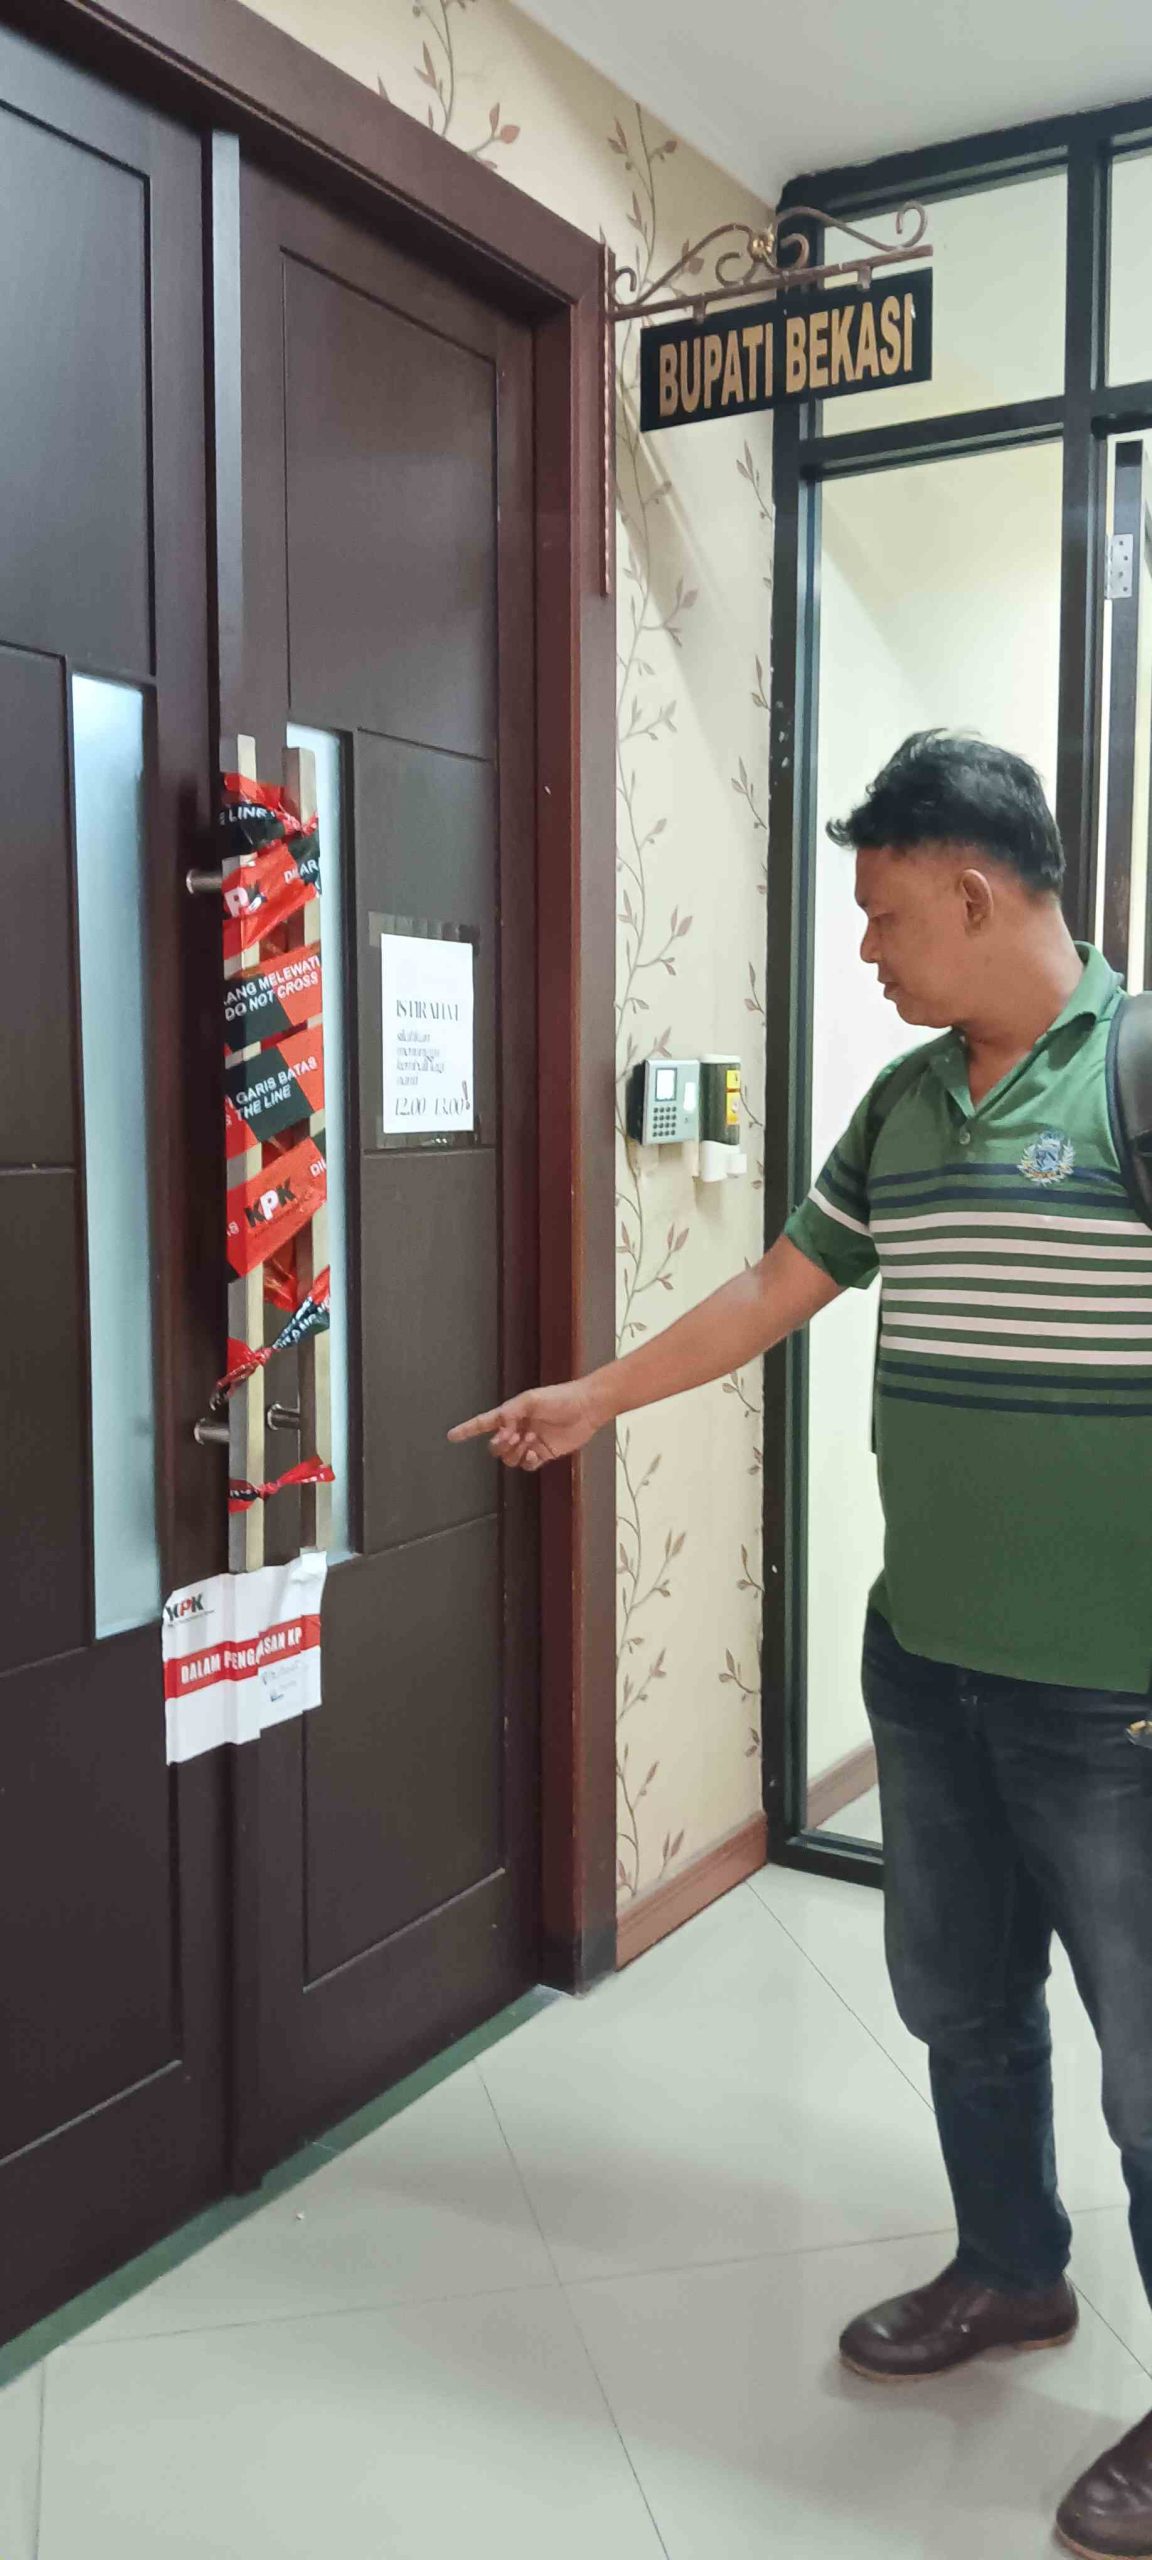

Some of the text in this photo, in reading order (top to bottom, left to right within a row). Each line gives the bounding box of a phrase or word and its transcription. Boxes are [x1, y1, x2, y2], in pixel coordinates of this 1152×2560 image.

[658, 292, 914, 417] BUPATI BEKASI
[258, 955, 321, 991] MELEWATI
[225, 971, 319, 1022] DO NOT CROSS
[235, 1077, 277, 1105] GARIS
[278, 1056, 318, 1086] BATAS
[235, 1100, 263, 1121] THE
[264, 1084, 292, 1109] LINE
[243, 1177, 297, 1228] KPK
[165, 1593, 204, 1622] KPK
[180, 1653, 222, 1685] DALAM
